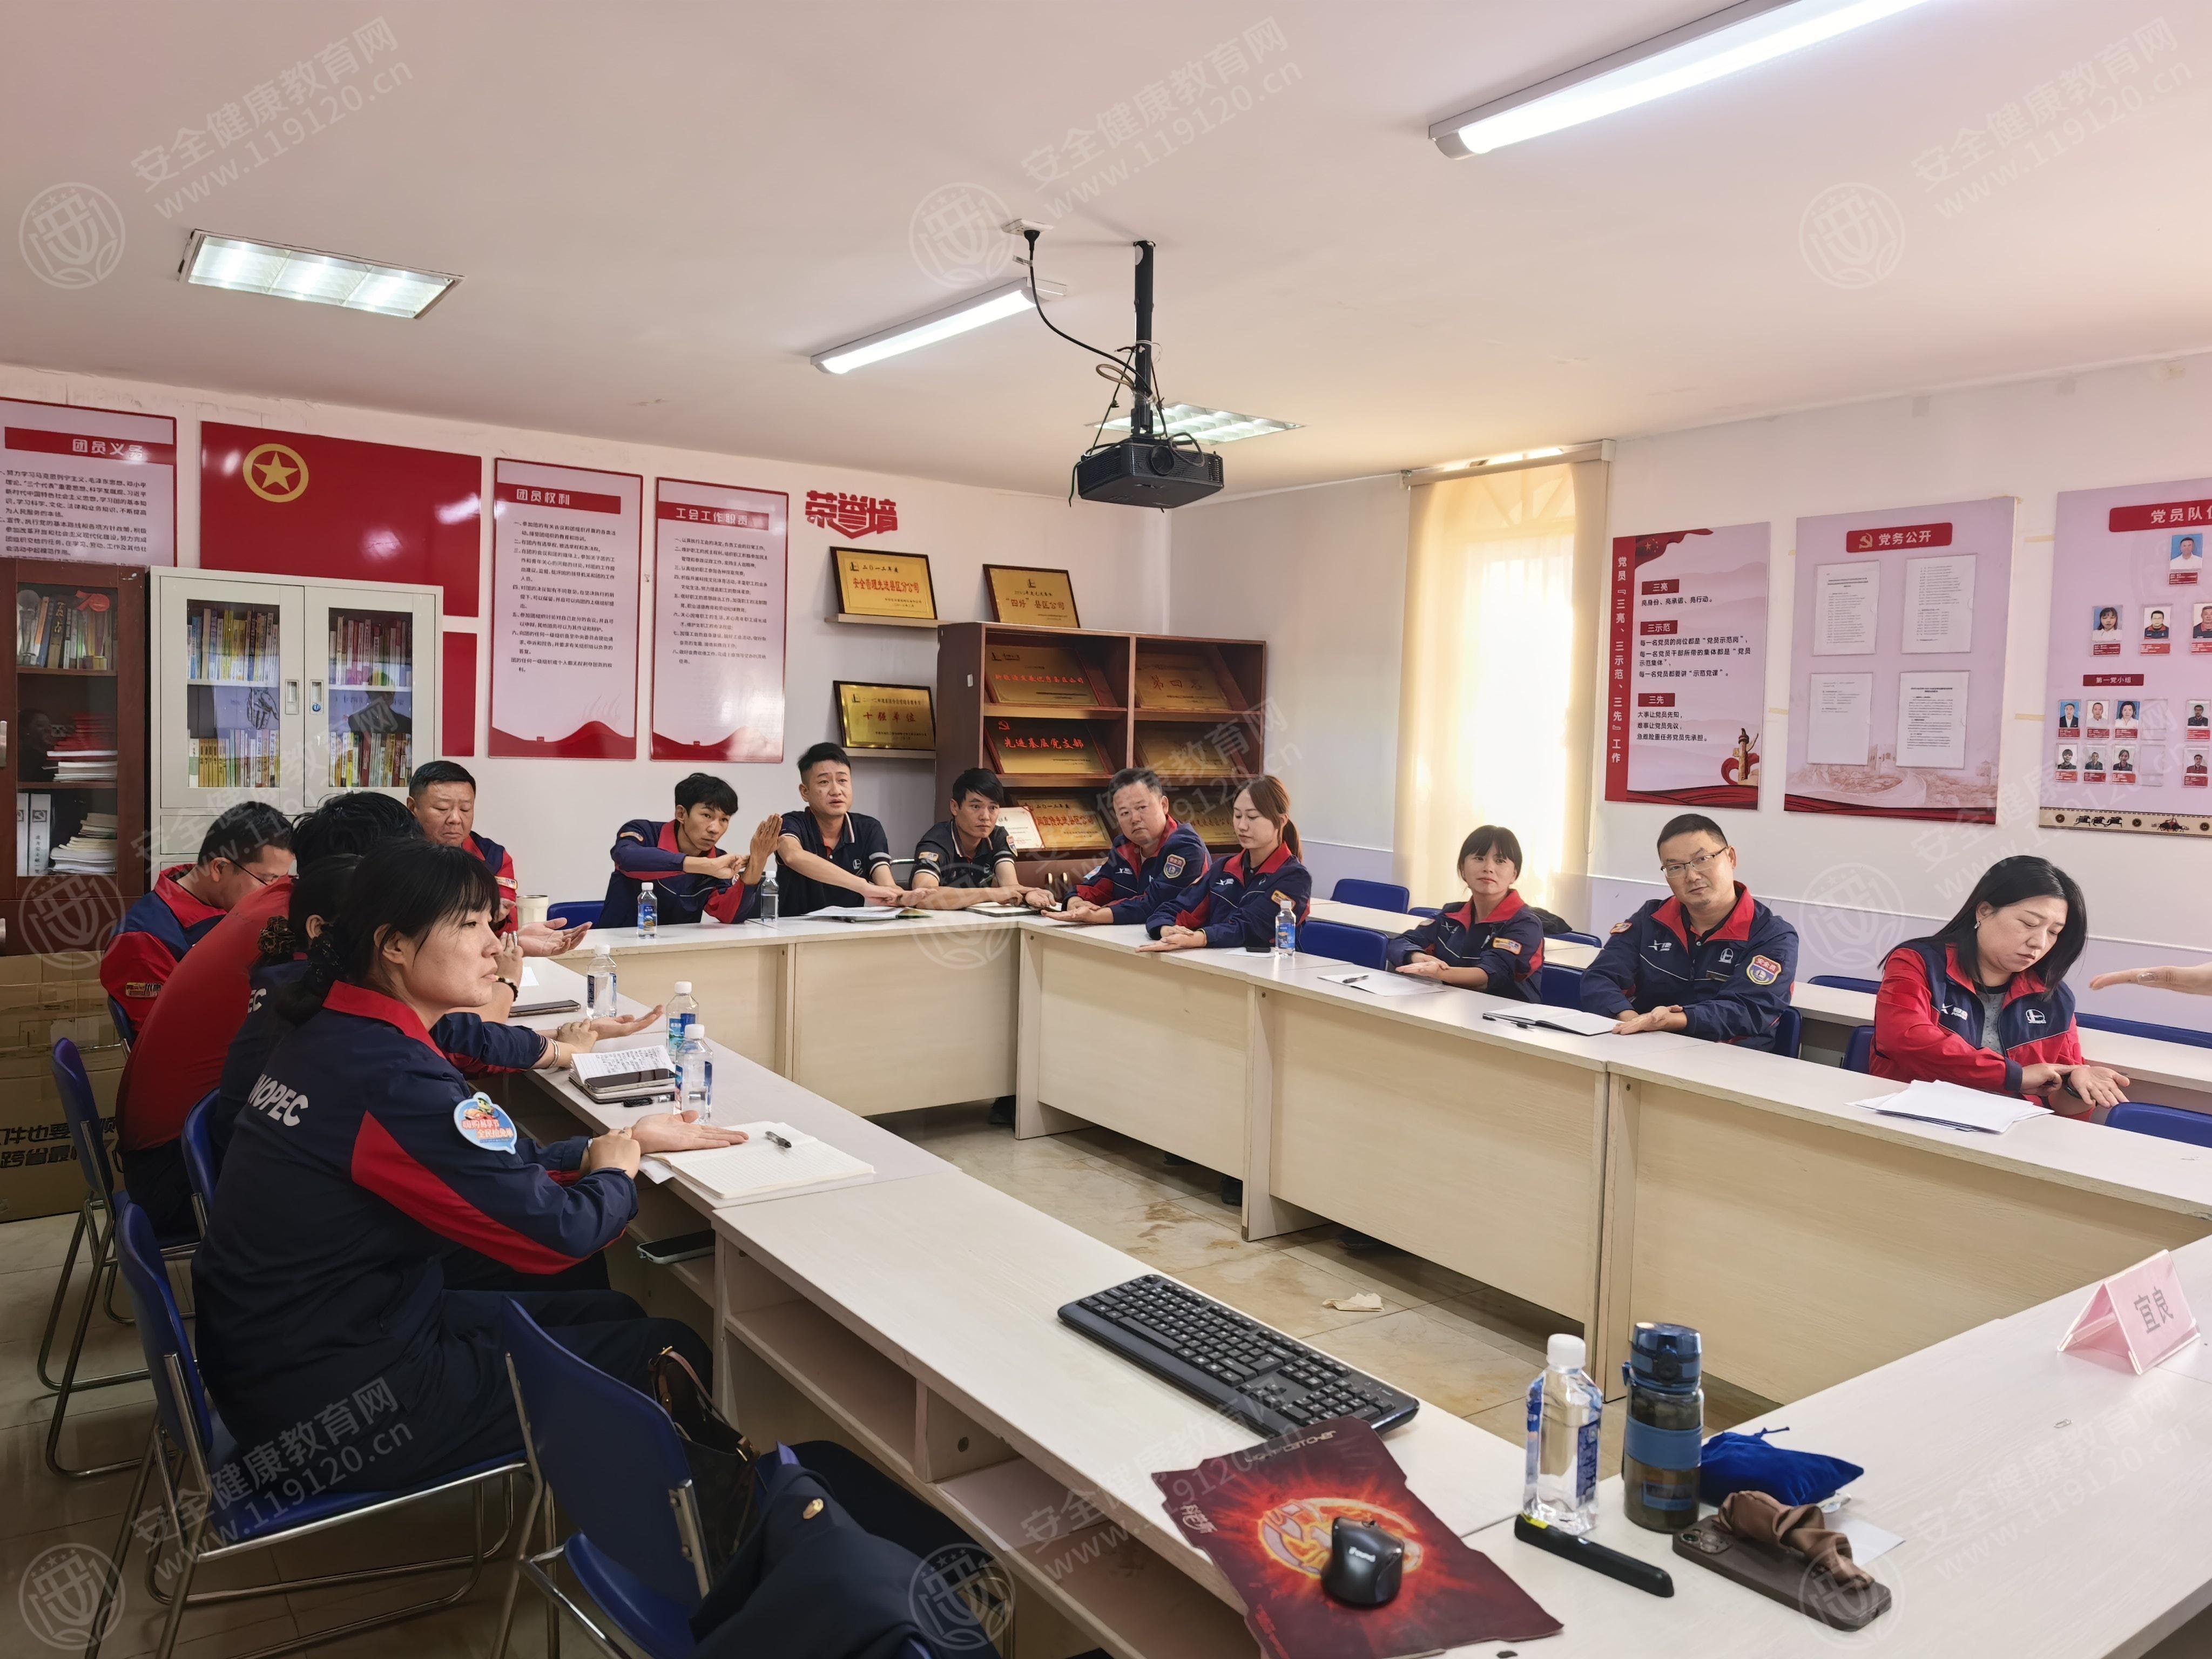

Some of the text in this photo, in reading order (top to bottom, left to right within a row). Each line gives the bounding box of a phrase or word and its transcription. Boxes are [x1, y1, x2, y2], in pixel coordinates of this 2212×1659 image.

[72, 439, 143, 458] 团员义务
[517, 489, 570, 505] 团员权利
[676, 508, 748, 525] 工会工作职责
[805, 490, 898, 539] 荣誉墙
[1878, 530, 1931, 546] 党务公开
[853, 577, 919, 593] 安全管理先进县区分公司
[1653, 583, 1668, 591] 三亮
[1647, 623, 1670, 632] 三示范
[1648, 696, 1664, 704] 三先
[863, 712, 916, 723] 十强单位
[1004, 737, 1084, 749] 先进基层党支部
[2134, 1286, 2174, 1334] 宜良
